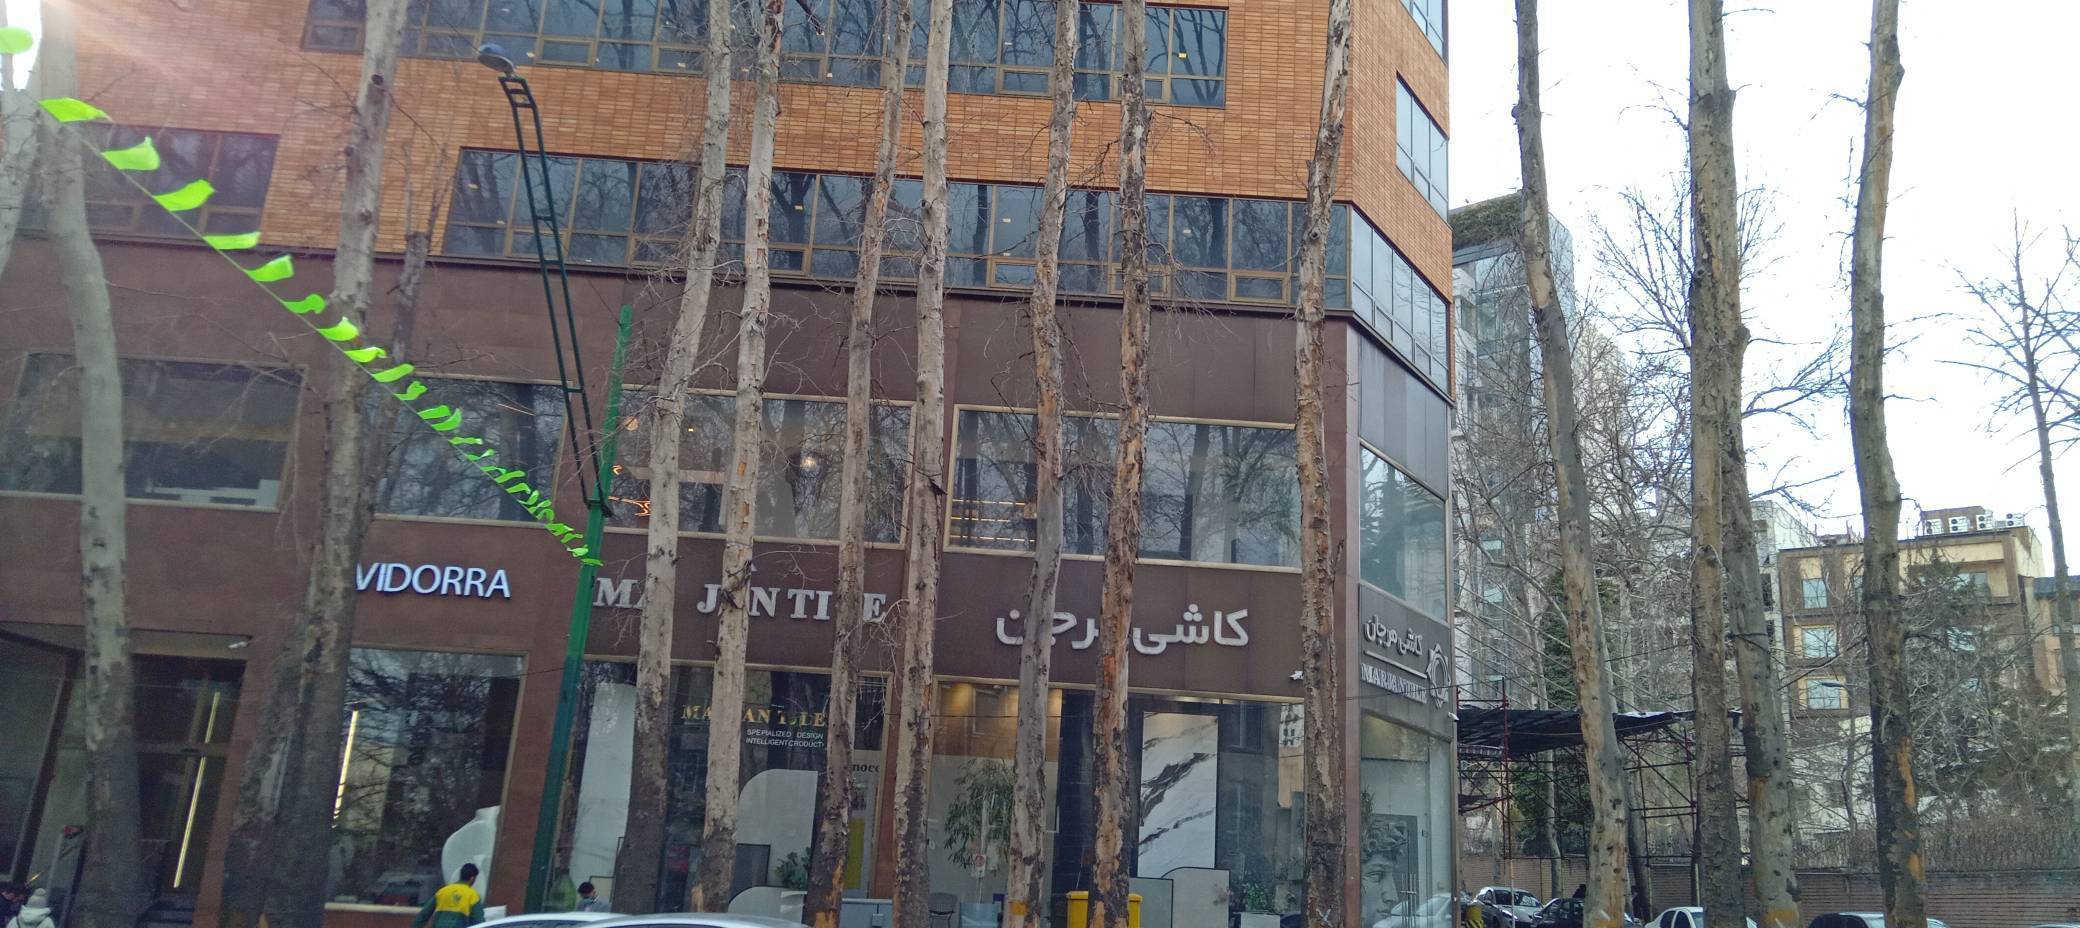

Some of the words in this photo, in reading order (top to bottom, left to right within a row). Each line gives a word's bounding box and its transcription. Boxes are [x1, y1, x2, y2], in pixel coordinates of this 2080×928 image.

[355, 562, 511, 598] VIDORRA
[593, 577, 780, 617] MJN
[787, 588, 886, 623] TIE
[1132, 603, 1249, 655] کاشی
[680, 704, 772, 724] MAAN
